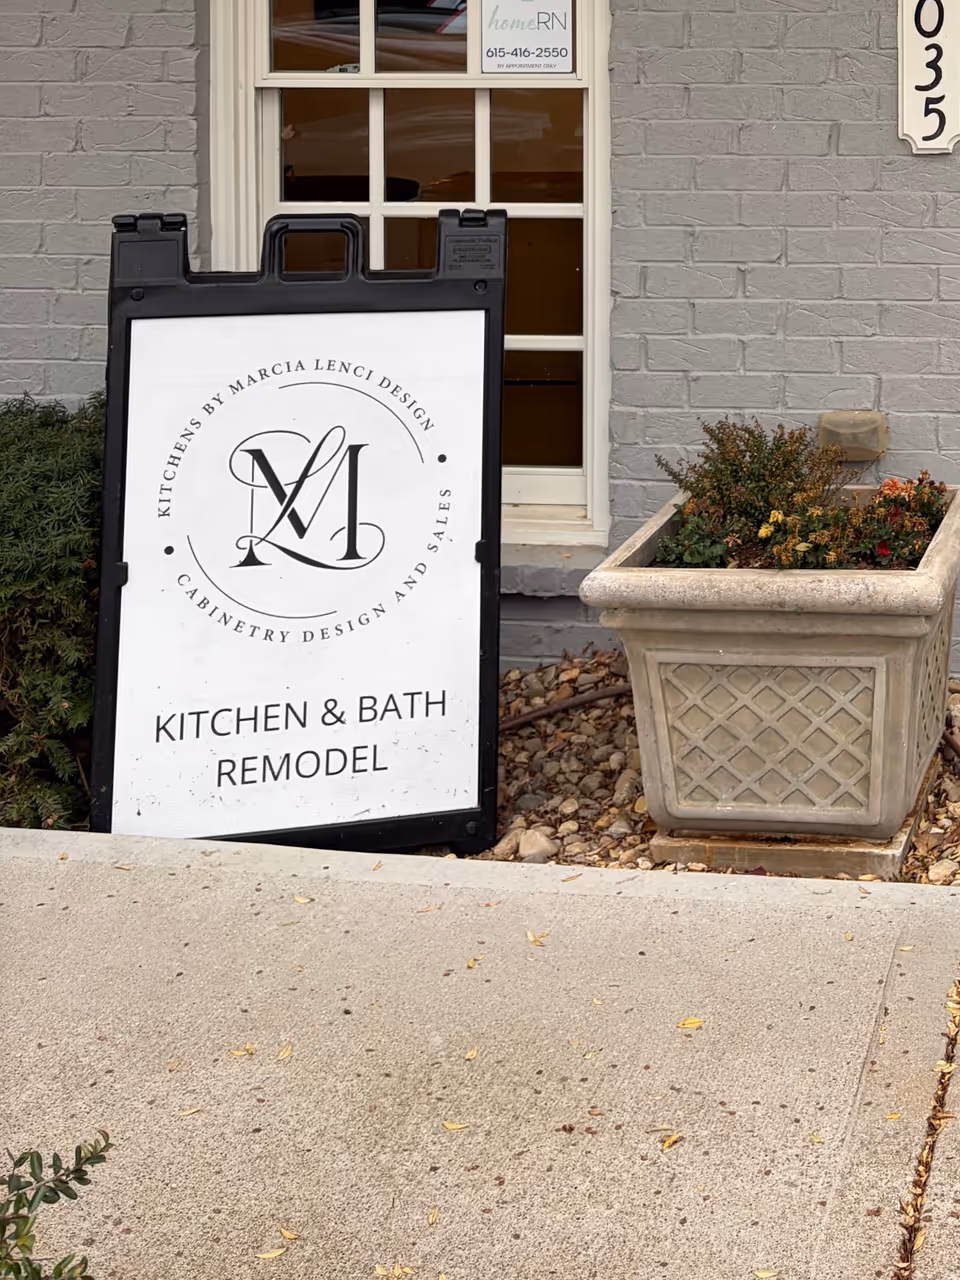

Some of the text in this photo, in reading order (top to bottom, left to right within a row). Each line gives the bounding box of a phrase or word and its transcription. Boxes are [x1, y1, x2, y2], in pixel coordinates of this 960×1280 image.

[486, 47, 569, 58] 615-416-2550
[157, 358, 435, 519] KITCHENS BY MARCIA LENCI DESIGN
[176, 488, 452, 644] CABINETRY DESIGN AND SALES
[155, 689, 447, 743] KITCHEN & BATH
[217, 744, 389, 788] REMODEL
